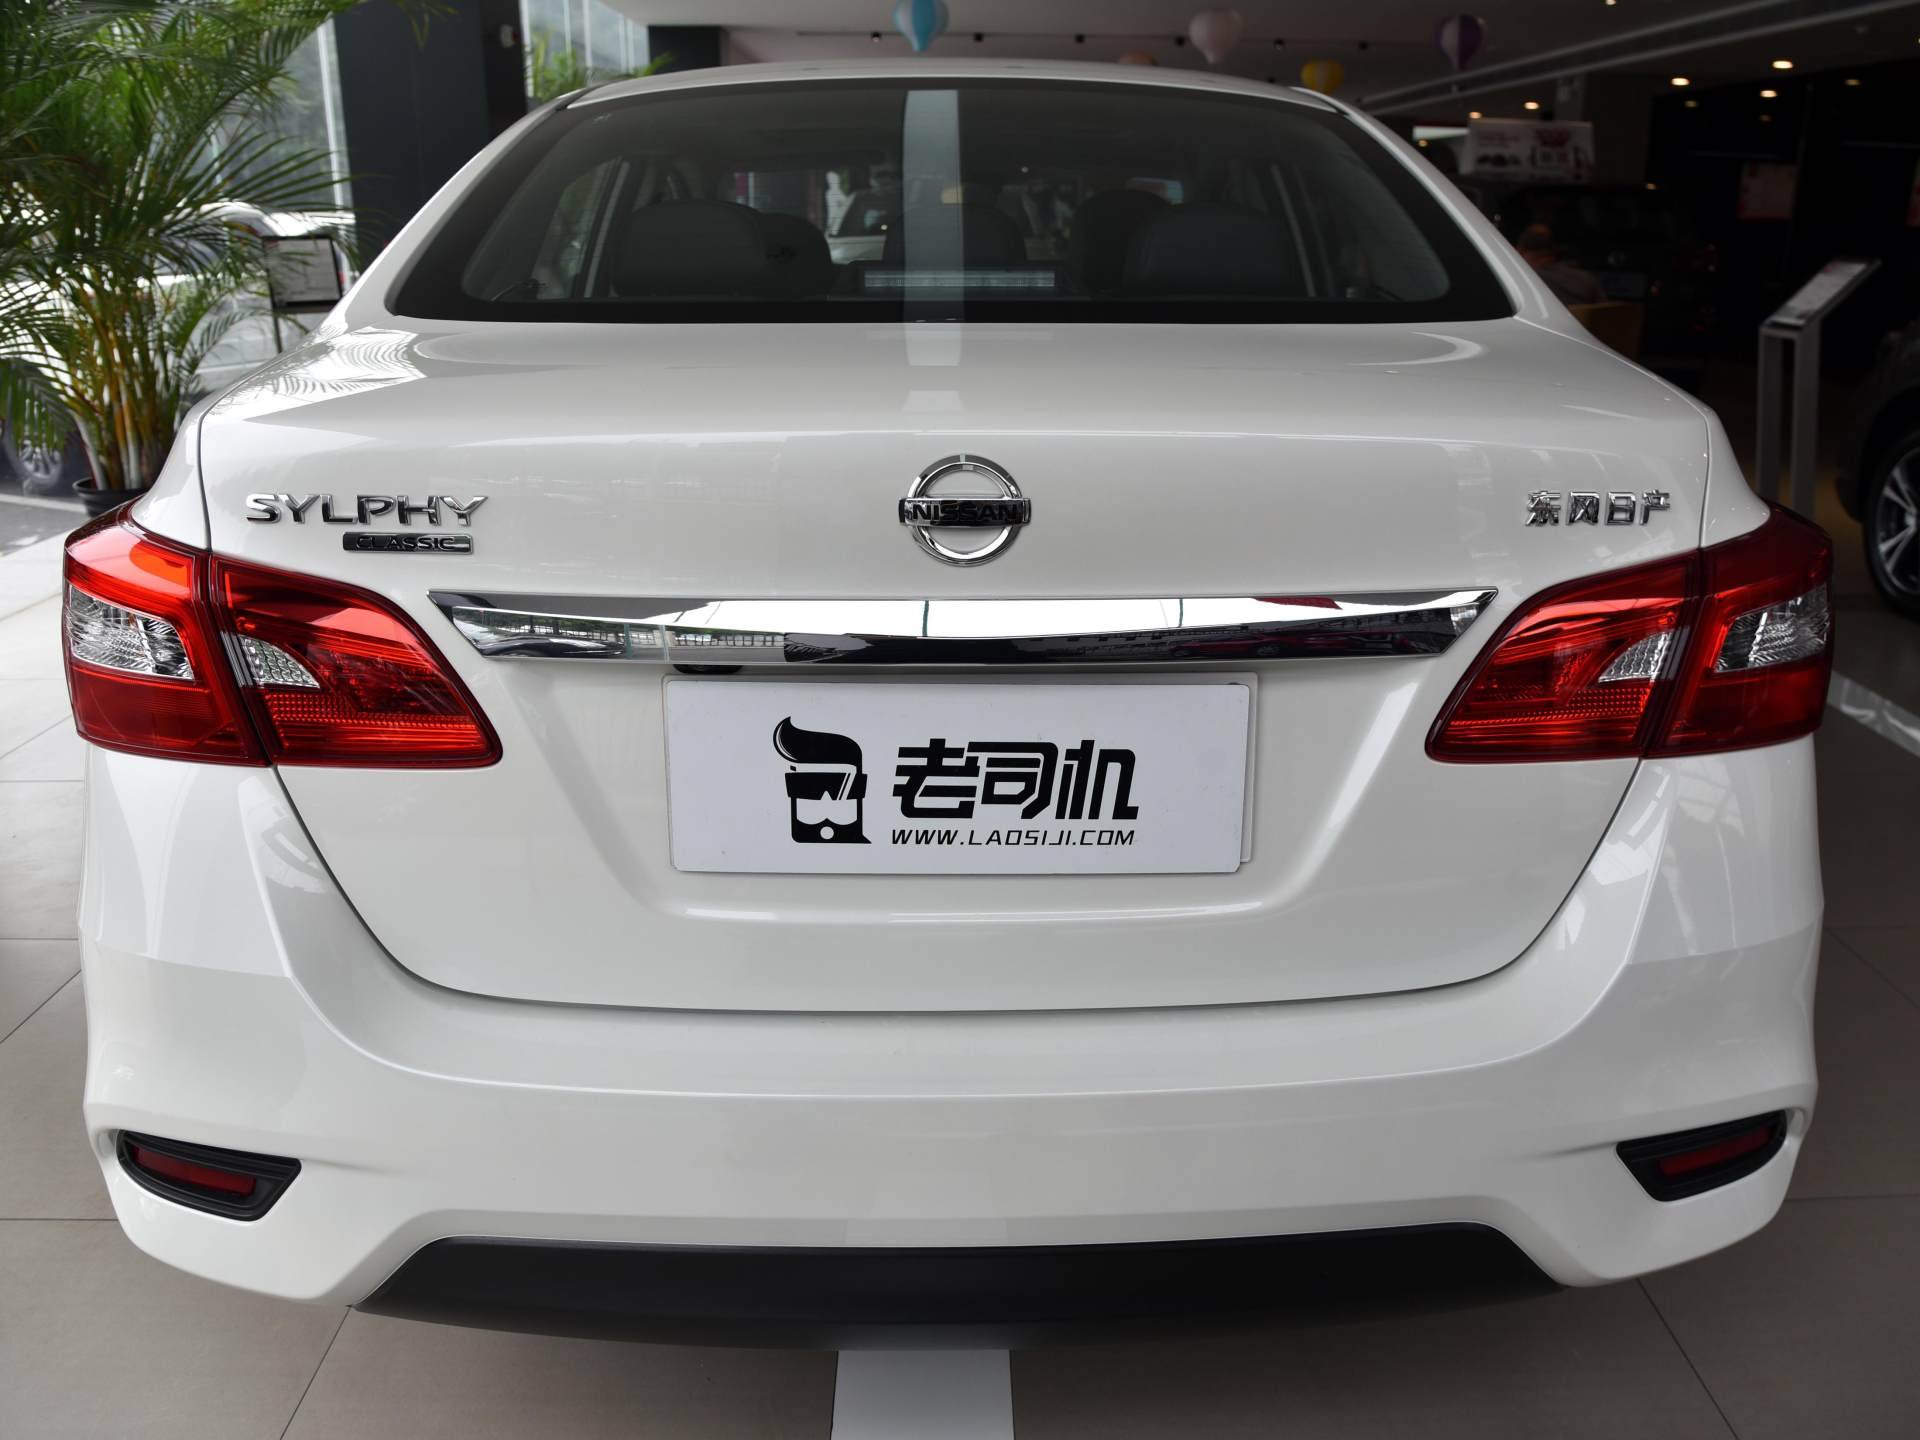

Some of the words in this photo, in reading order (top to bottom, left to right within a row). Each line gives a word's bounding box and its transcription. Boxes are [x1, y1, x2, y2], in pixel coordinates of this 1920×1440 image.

[245, 493, 488, 526] SYLPHY
[911, 502, 1019, 522] NISSAN
[1525, 490, 1671, 526] 东风日产
[355, 535, 456, 551] CLASSIC
[892, 738, 1139, 820] 老司机
[892, 829, 1135, 846] WWW.LAOSIJI.COM
